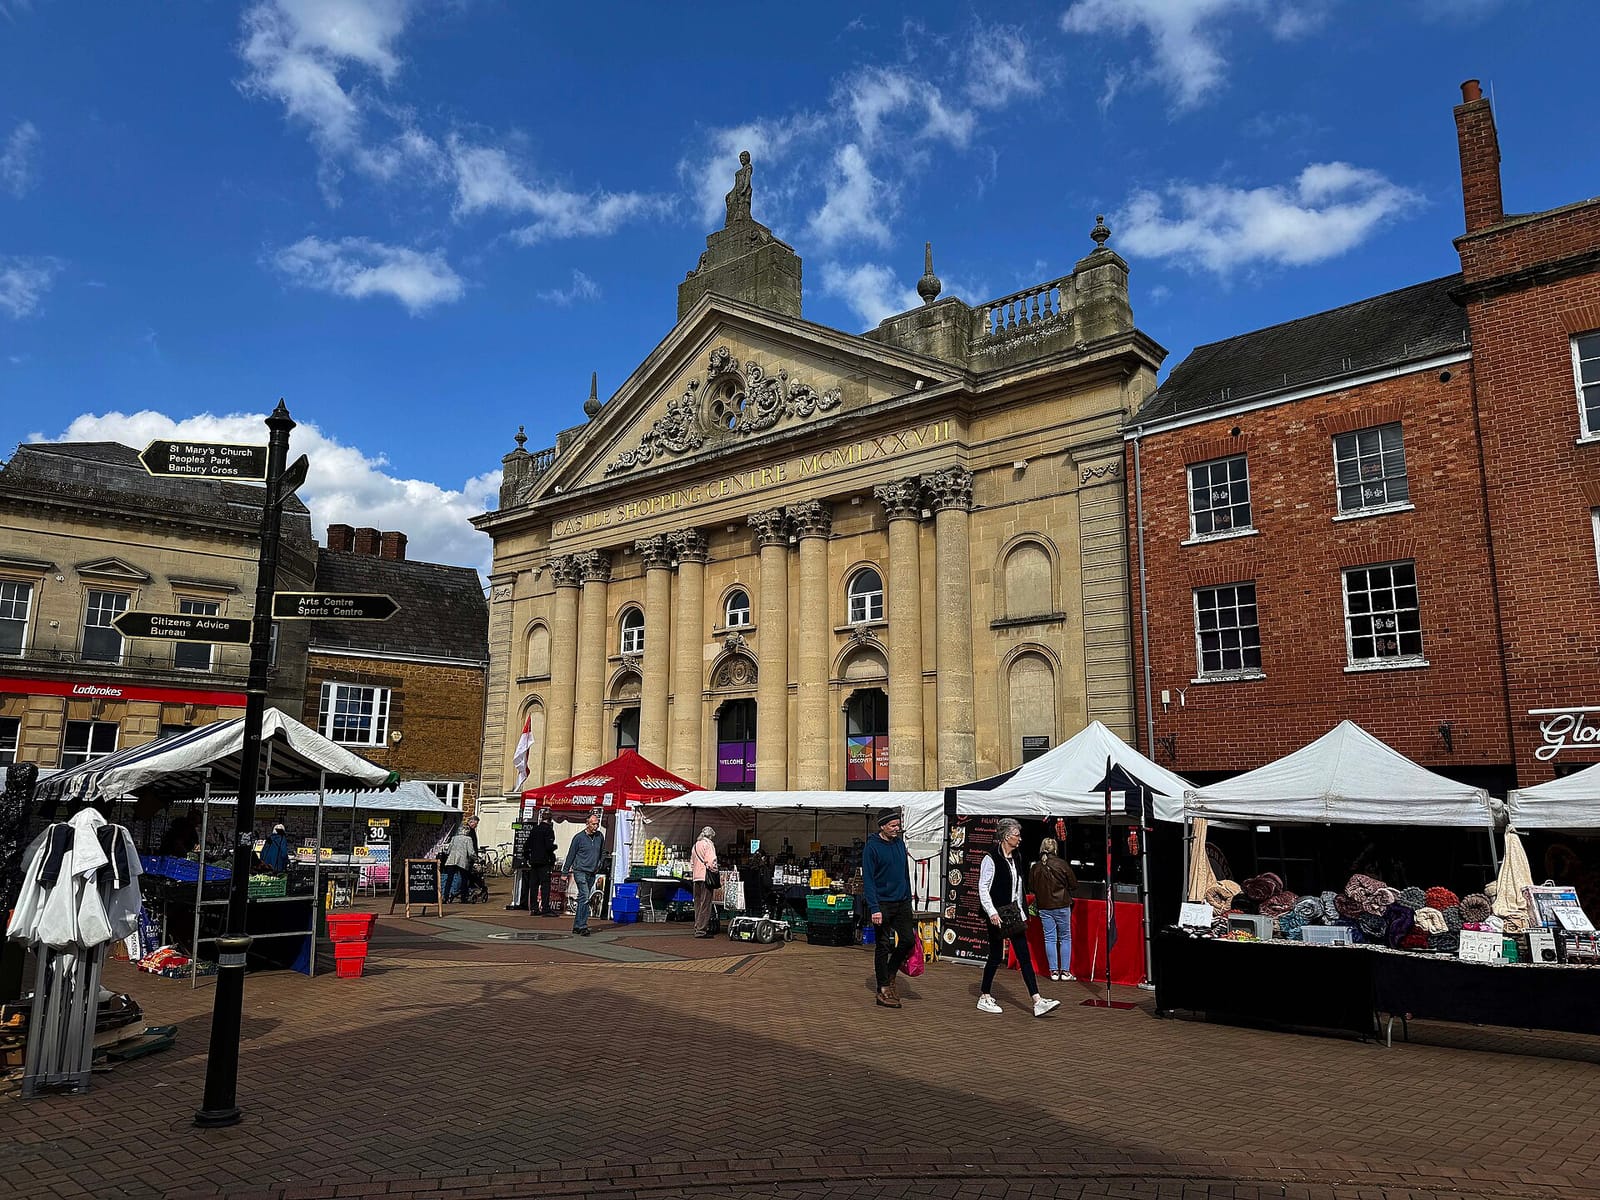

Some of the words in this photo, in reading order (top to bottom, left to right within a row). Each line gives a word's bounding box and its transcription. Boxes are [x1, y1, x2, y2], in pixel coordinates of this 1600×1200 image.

[169, 445, 180, 453] St
[185, 446, 215, 455] Mary's
[220, 448, 253, 456] Church
[169, 455, 205, 464] Peoples
[210, 457, 231, 465] Park
[168, 464, 207, 474] Banbury
[211, 466, 238, 475] Cross
[554, 508, 612, 536] CASTLE
[617, 485, 701, 521] SHOPPING
[706, 462, 788, 499] CENTRE
[799, 419, 950, 476] MCMLXXVII
[298, 597, 319, 607] Arts
[324, 597, 354, 607] Centre
[298, 606, 328, 616] Sports
[333, 607, 363, 616] Centre
[151, 616, 191, 627] Citizens
[196, 619, 230, 630] Advice
[150, 627, 186, 637] Bureau
[72, 684, 123, 696] Ladbrokes
[572, 795, 598, 805] CUISINE
